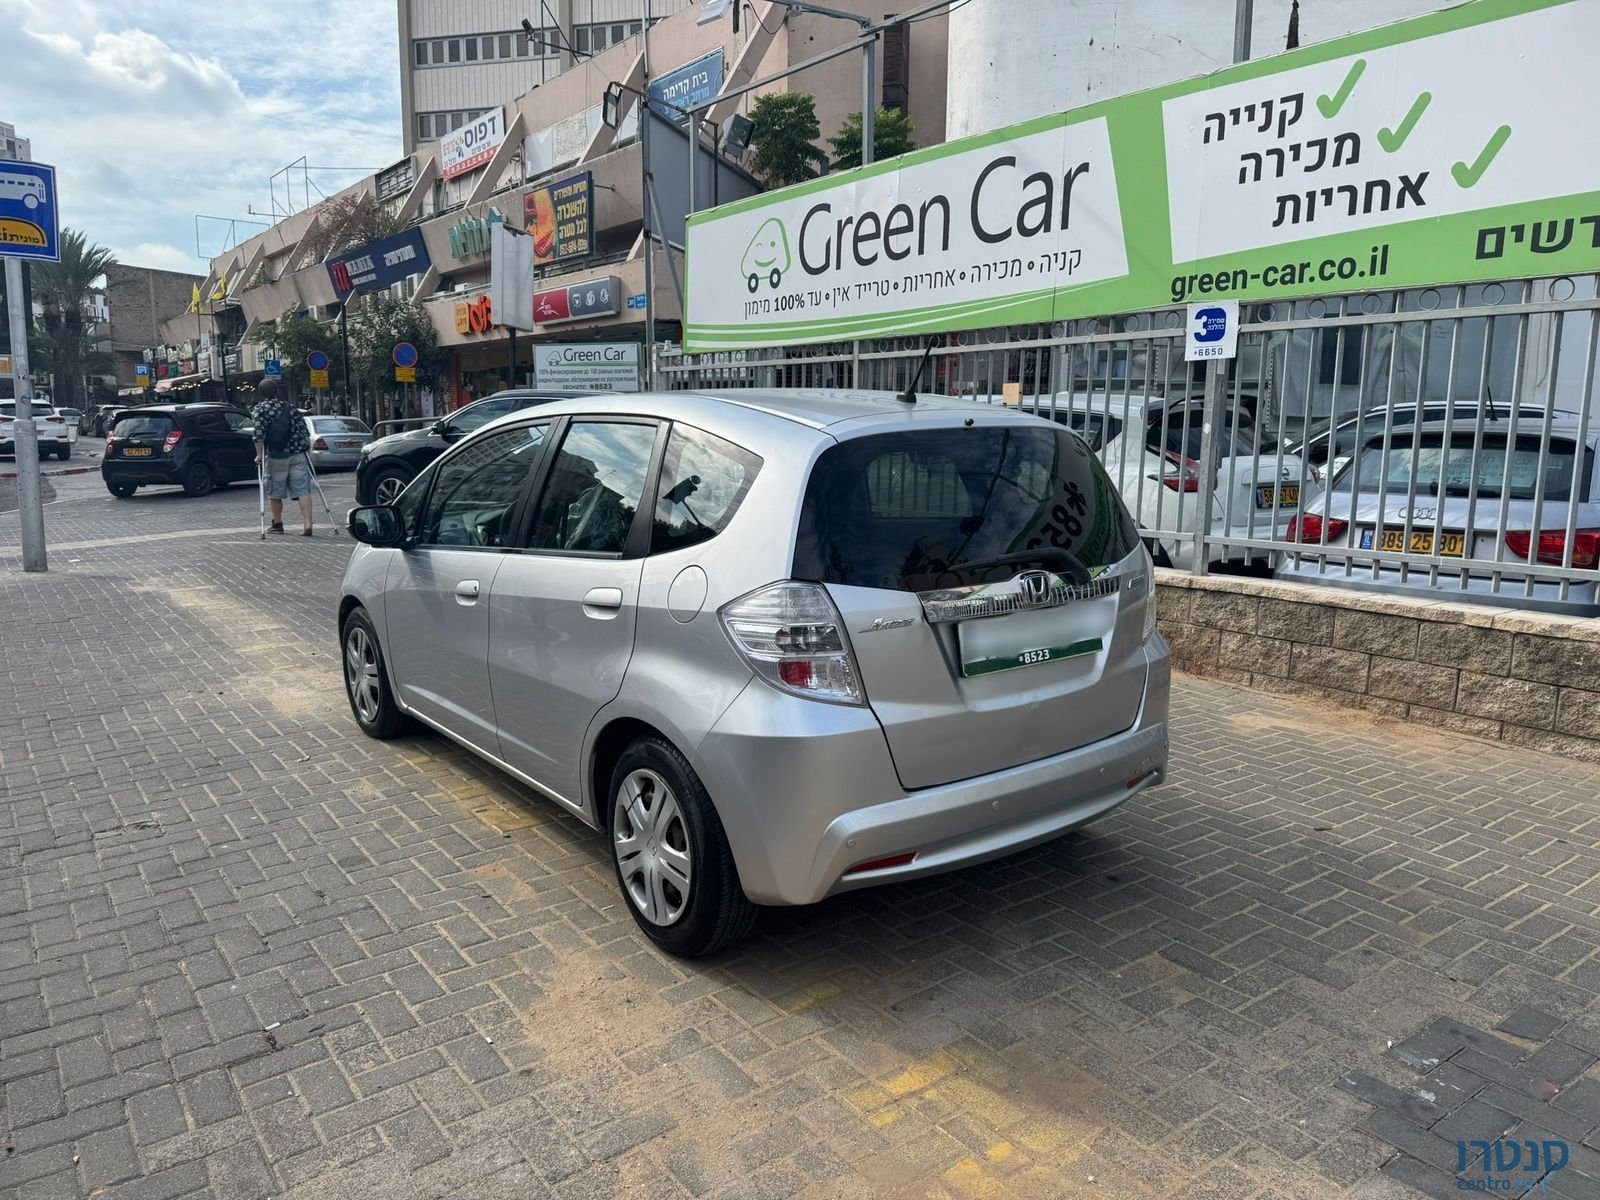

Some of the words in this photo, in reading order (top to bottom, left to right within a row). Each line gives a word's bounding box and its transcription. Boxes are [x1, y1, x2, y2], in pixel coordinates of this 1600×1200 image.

[663, 78, 690, 101] קדימה
[692, 71, 709, 89] בית
[1203, 92, 1304, 144] קנייה
[464, 116, 497, 148] דפוס
[1238, 131, 1361, 185] מכירה
[1272, 170, 1430, 228] אחריות
[798, 202, 951, 276] Green
[970, 156, 1090, 244] Car
[9, 233, 40, 244] מונית
[970, 258, 1022, 283] מכירה
[1039, 249, 1082, 275] קניה
[1170, 244, 1390, 302] green-car.co.il
[855, 279, 890, 300] טרייד
[902, 269, 956, 293] אחריות
[774, 293, 805, 312] 100%
[807, 290, 822, 307] עד
[832, 285, 851, 308] אין
[744, 298, 770, 320] מימון
[563, 348, 601, 362] Green
[604, 347, 626, 361] Car
[1411, 533, 1433, 550] 25
